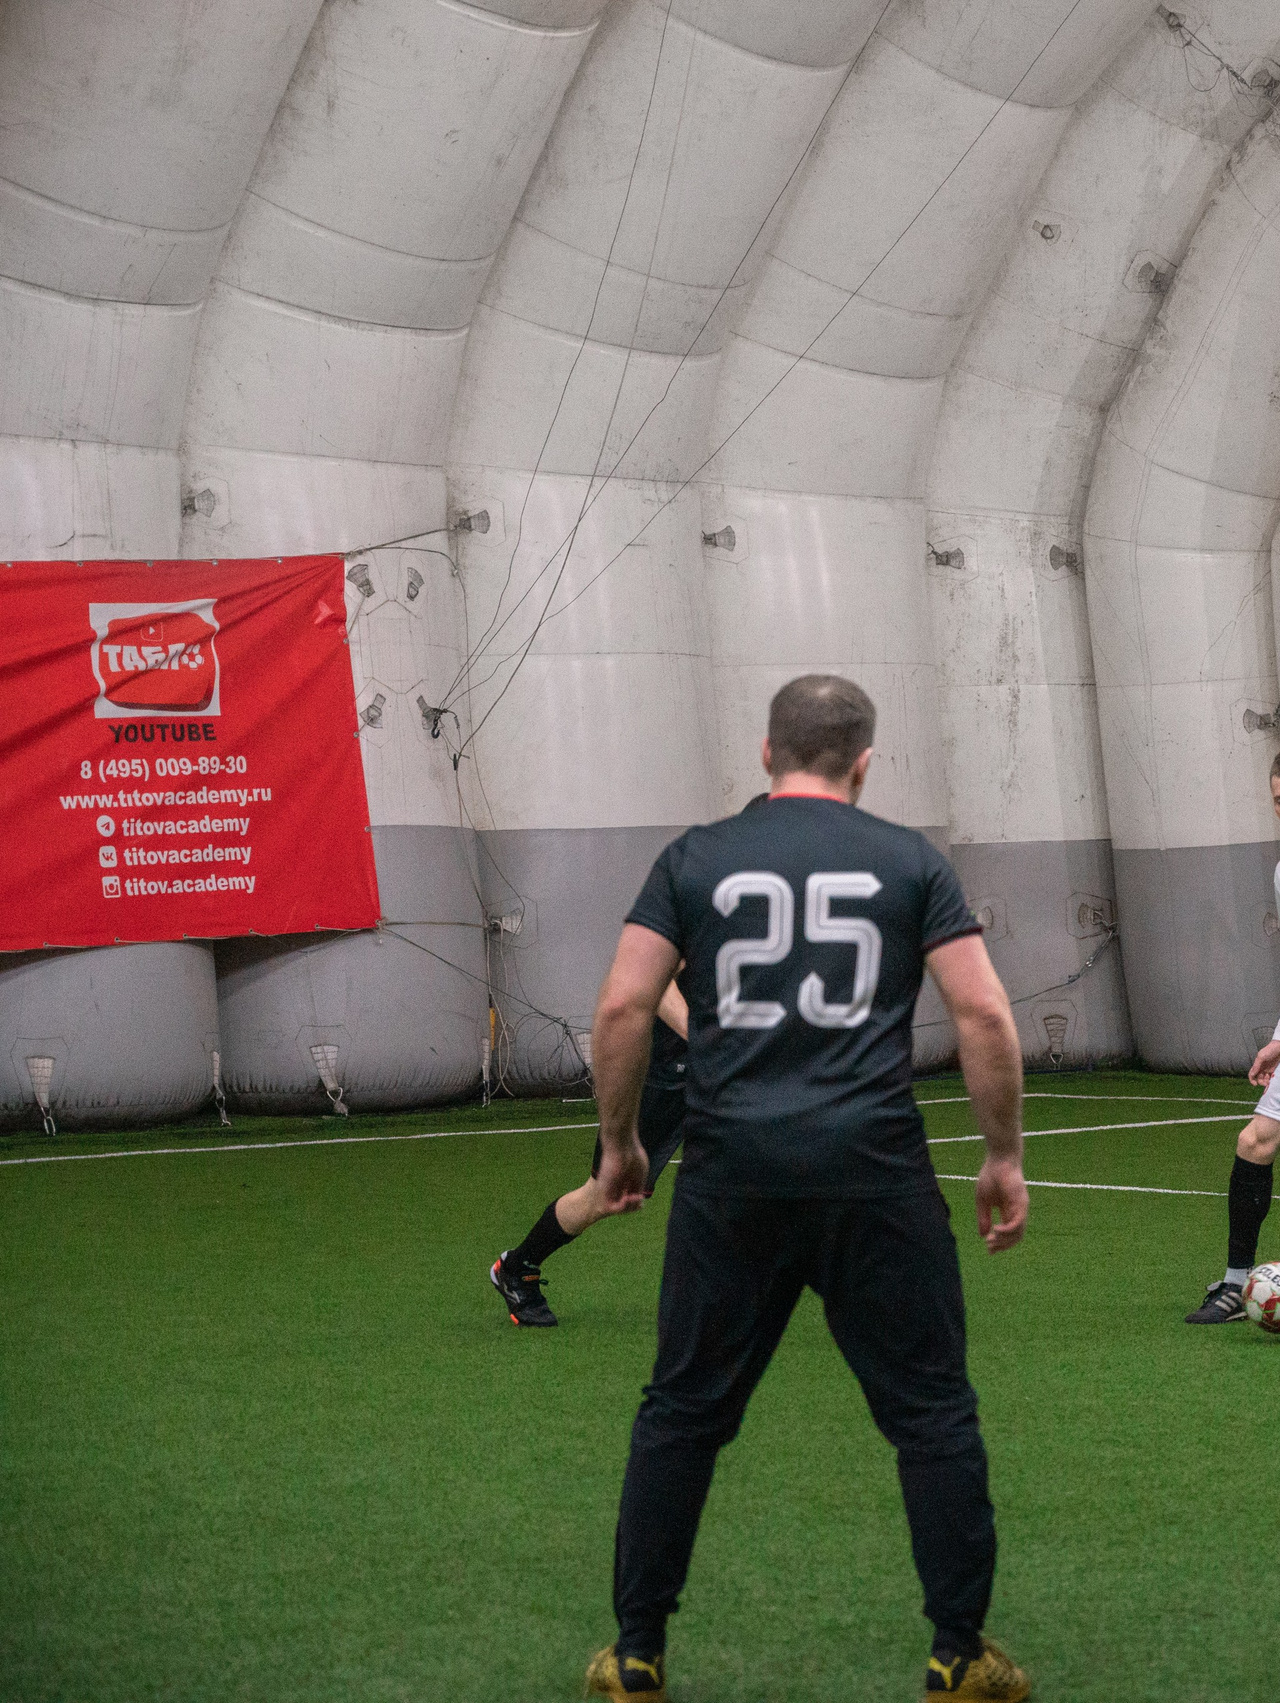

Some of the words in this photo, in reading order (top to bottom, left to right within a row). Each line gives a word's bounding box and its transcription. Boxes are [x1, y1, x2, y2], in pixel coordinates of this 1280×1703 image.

[108, 723, 217, 744] YOUTUBE
[80, 760, 92, 779] 8
[99, 759, 149, 783] (495)
[155, 755, 247, 776] 009-89-30
[59, 786, 272, 810] www.titovacademy.ru
[122, 815, 250, 836] titovacademy
[123, 844, 252, 866] titovacademy
[124, 874, 256, 896] titov.academy
[711, 871, 884, 1030] 25
